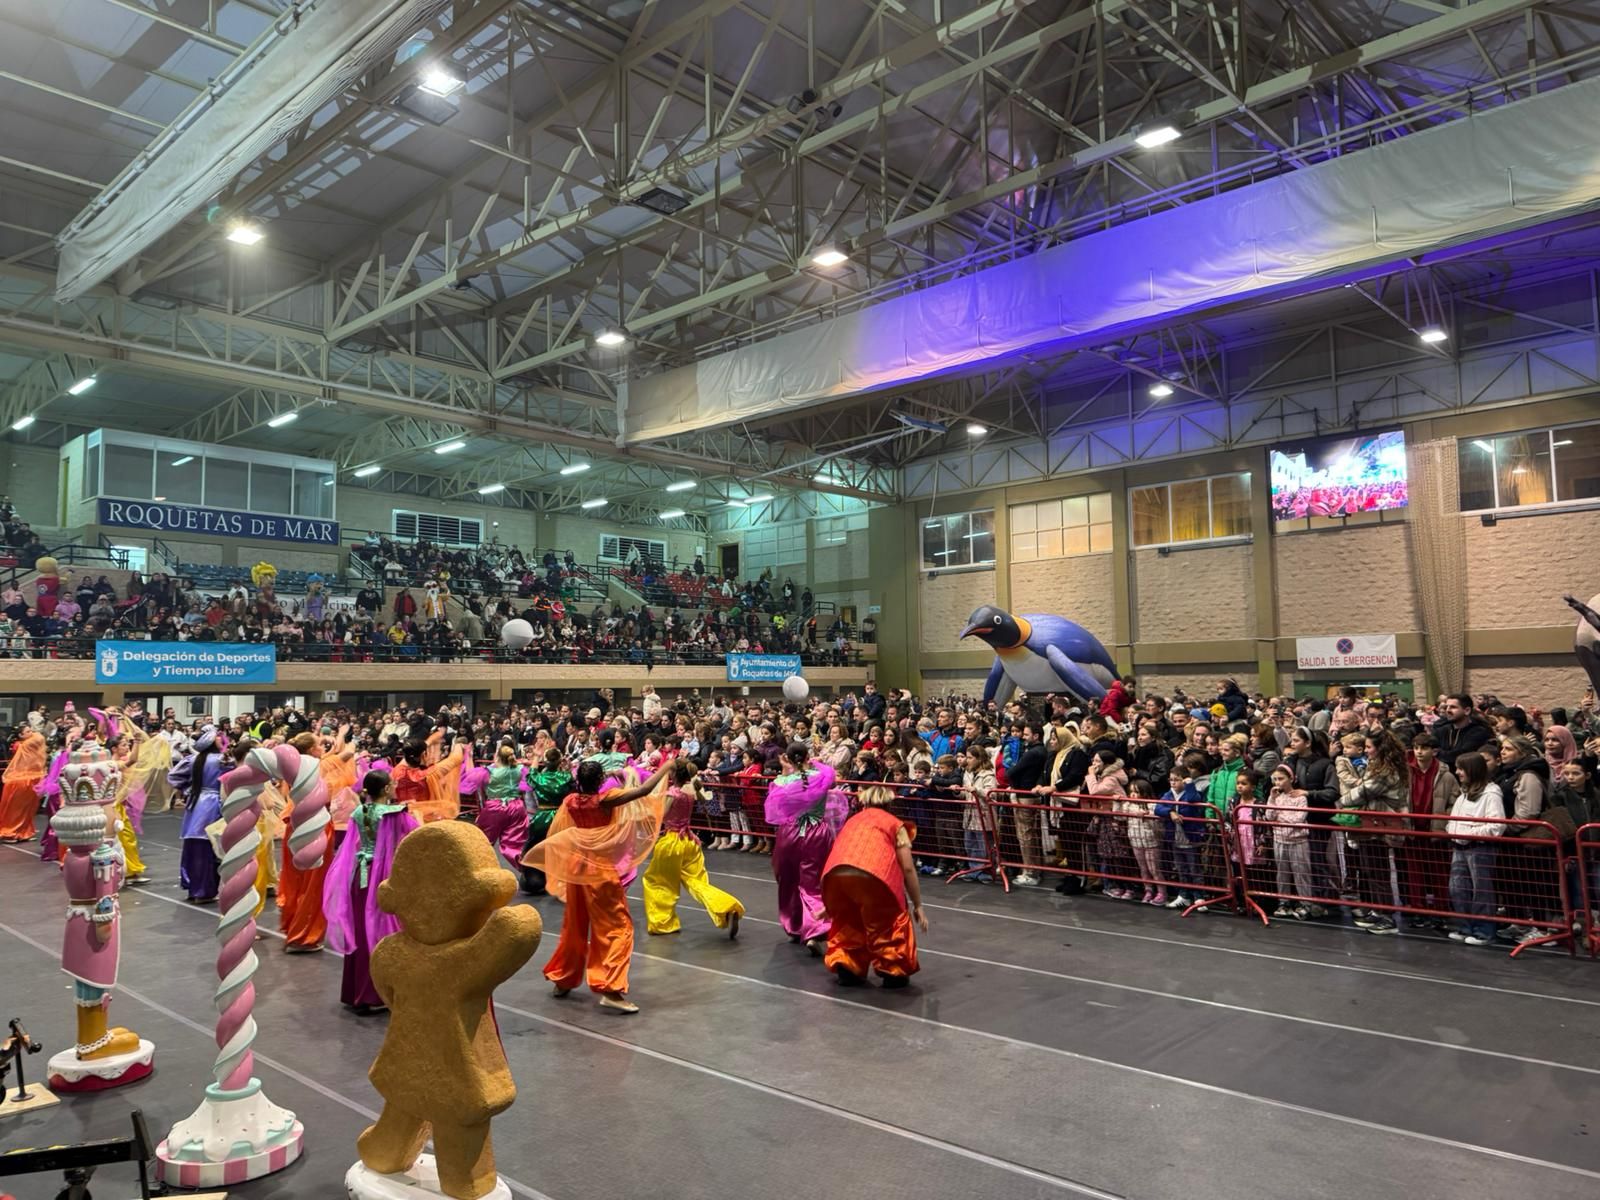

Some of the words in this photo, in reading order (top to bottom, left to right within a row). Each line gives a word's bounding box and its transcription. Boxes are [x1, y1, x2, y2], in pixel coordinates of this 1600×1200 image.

[108, 502, 243, 534] ROQUETAS
[251, 519, 276, 536] DE
[284, 519, 333, 542] MAR
[123, 651, 196, 664] Delegación
[199, 652, 215, 662] de
[217, 652, 271, 664] Deportes
[1299, 657, 1327, 667] SALIDA
[1329, 656, 1340, 666] DE
[1343, 655, 1396, 666] EMERGENCIA
[153, 667, 162, 678] y
[163, 665, 212, 677] Tiempo
[214, 665, 245, 676] Libre
